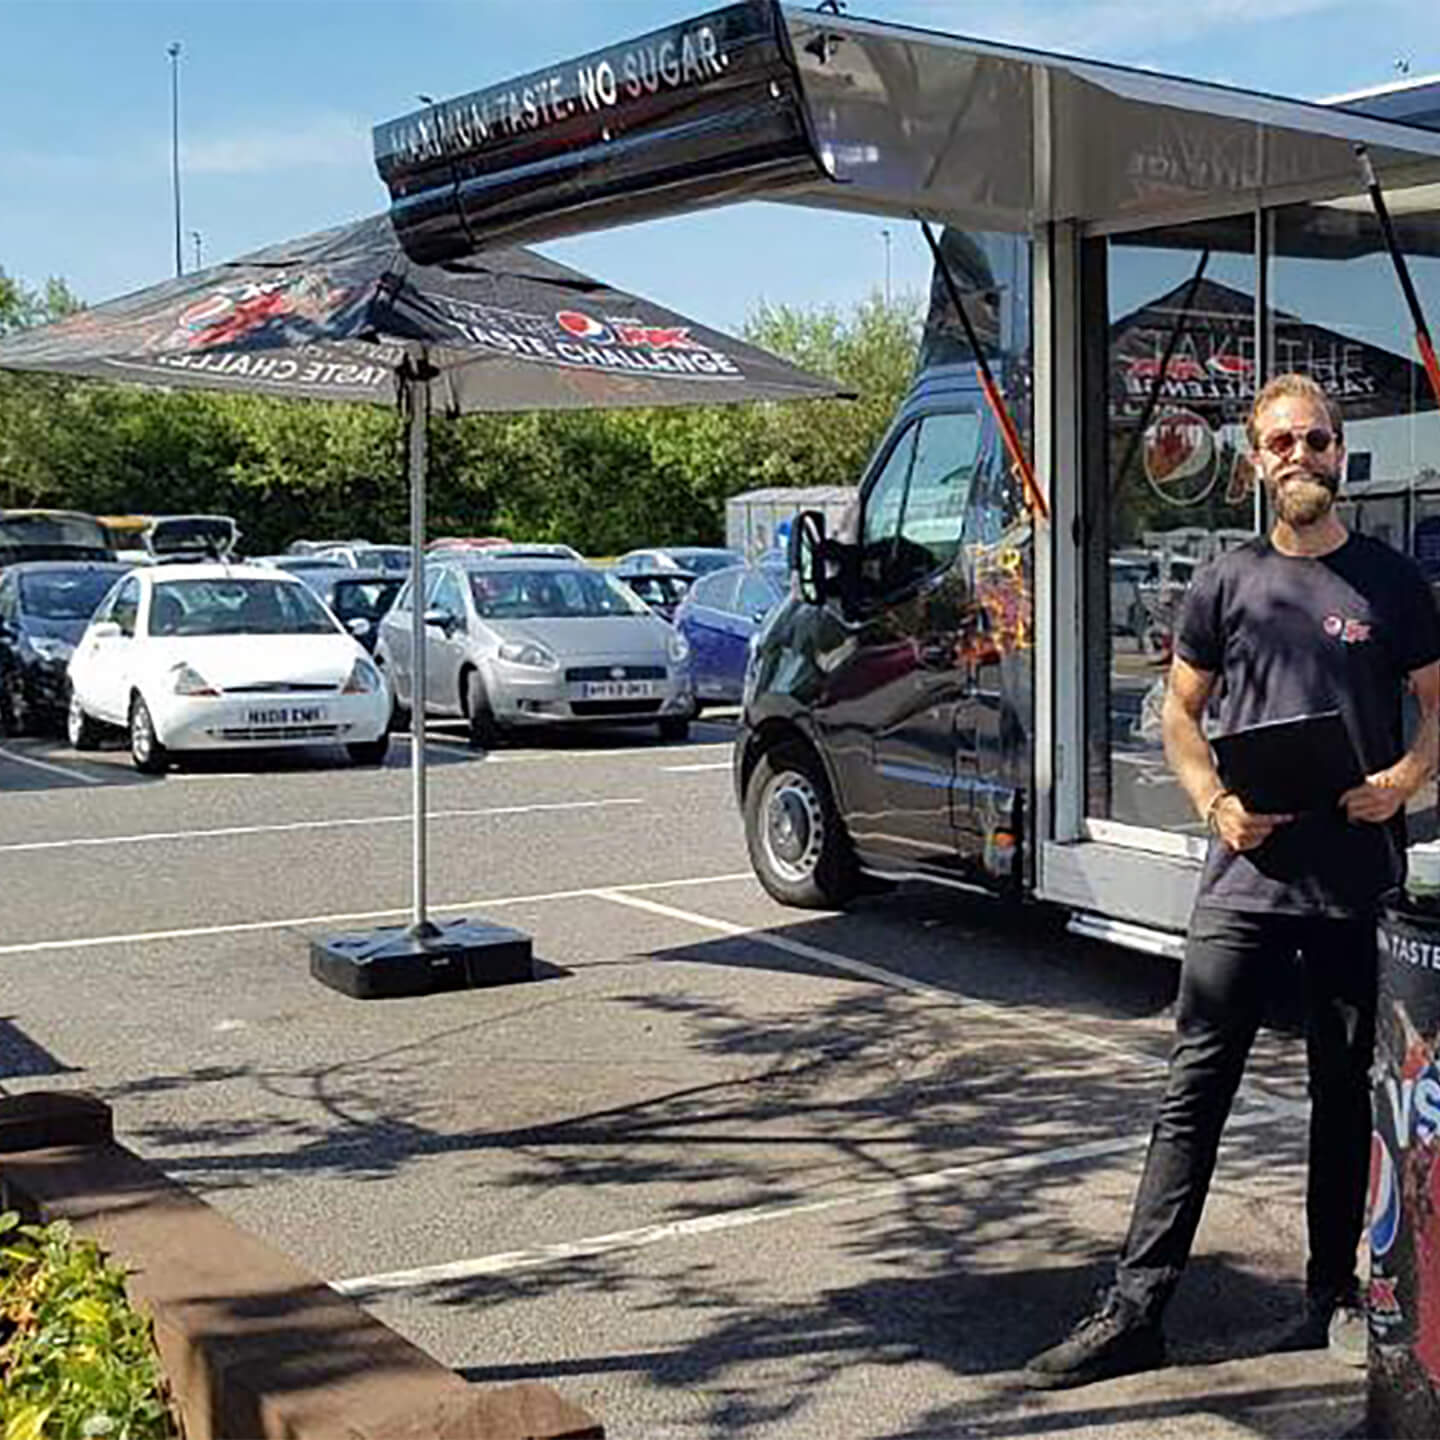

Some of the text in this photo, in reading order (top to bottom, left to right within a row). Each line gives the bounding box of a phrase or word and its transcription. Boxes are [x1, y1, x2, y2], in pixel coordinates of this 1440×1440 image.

[578, 63, 617, 112] NO
[625, 26, 731, 97] SUGAR.
[556, 342, 738, 374] CHALLENGE
